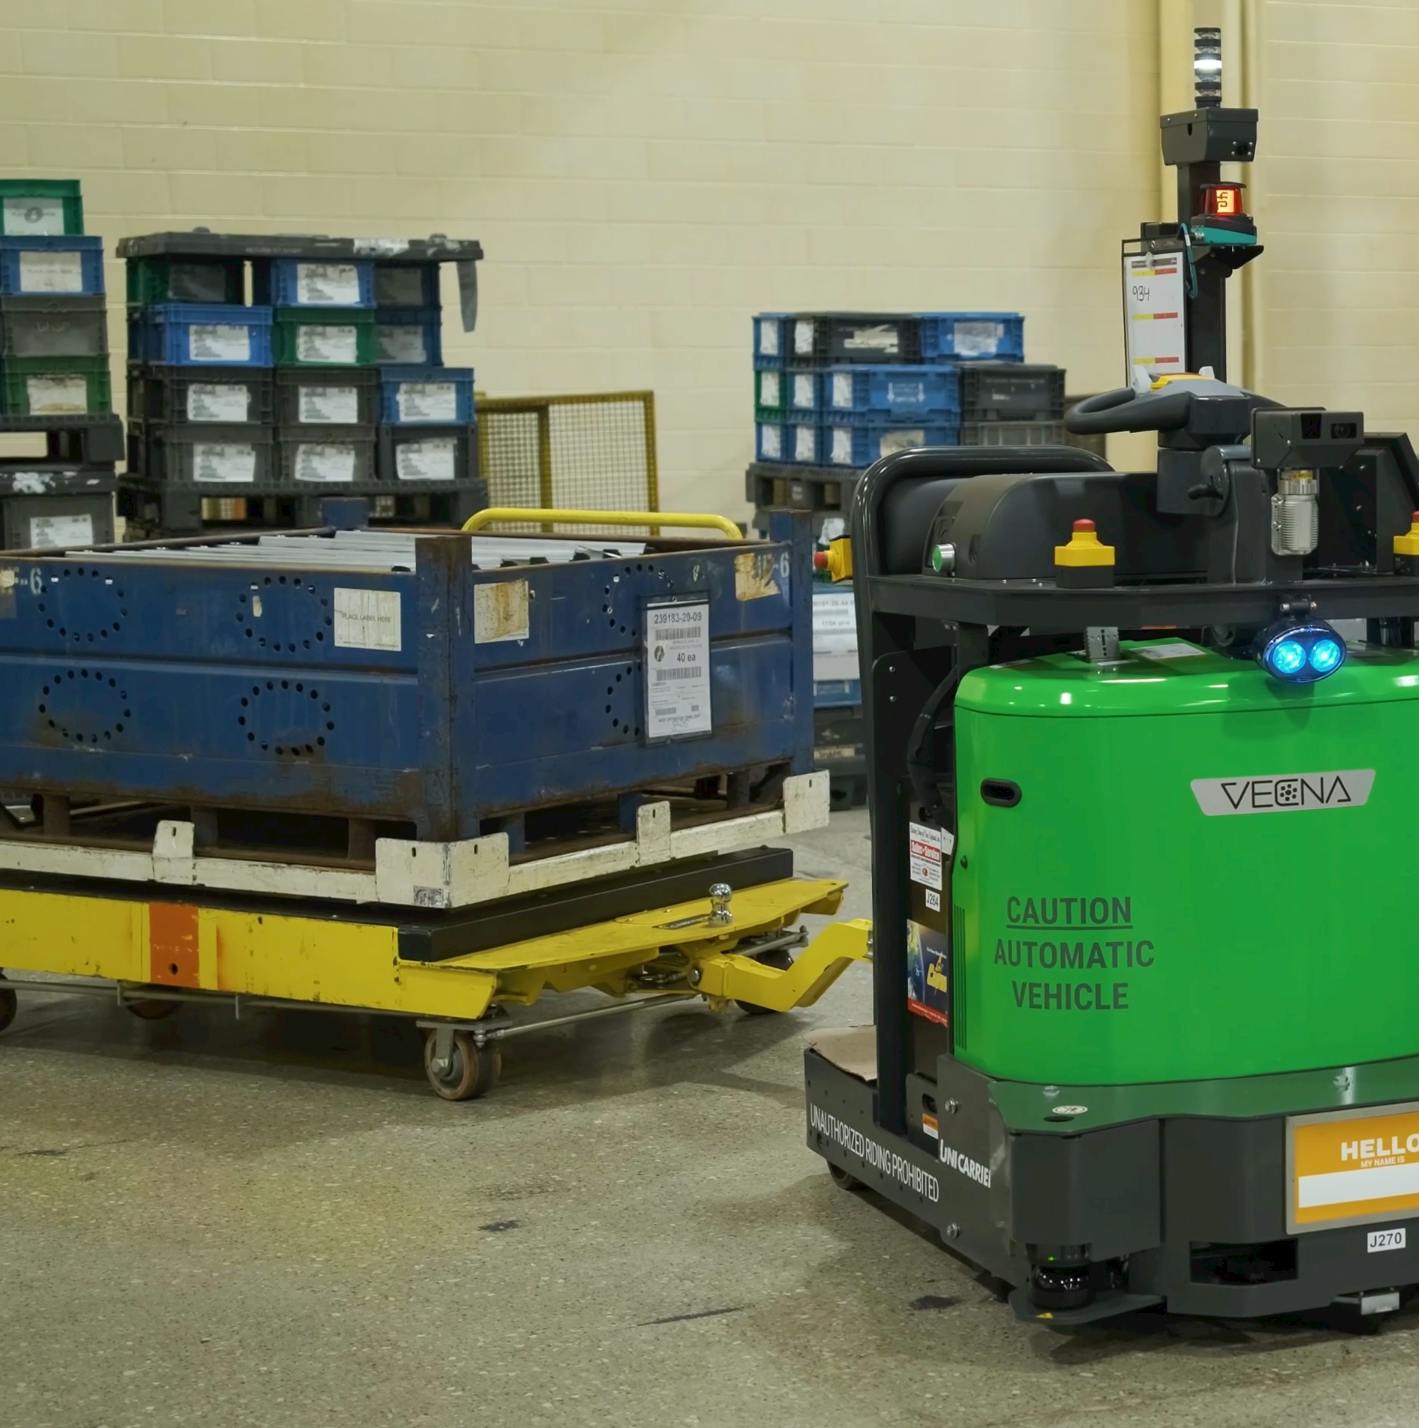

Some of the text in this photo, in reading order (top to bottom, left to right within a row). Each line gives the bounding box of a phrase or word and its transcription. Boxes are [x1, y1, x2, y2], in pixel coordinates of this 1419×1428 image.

[1132, 285, 1150, 301] 934
[1220, 776, 1352, 810] VECNA
[1007, 896, 1132, 925] CAUTION
[994, 938, 1154, 969] AUTOMATIC
[1012, 981, 1129, 1011] VEHICLE
[810, 1103, 940, 1203] UNAUTHORIZED RIDING PROHIBITED
[1360, 1156, 1405, 1169] MY NAME IS
[1370, 1232, 1402, 1248] J270
